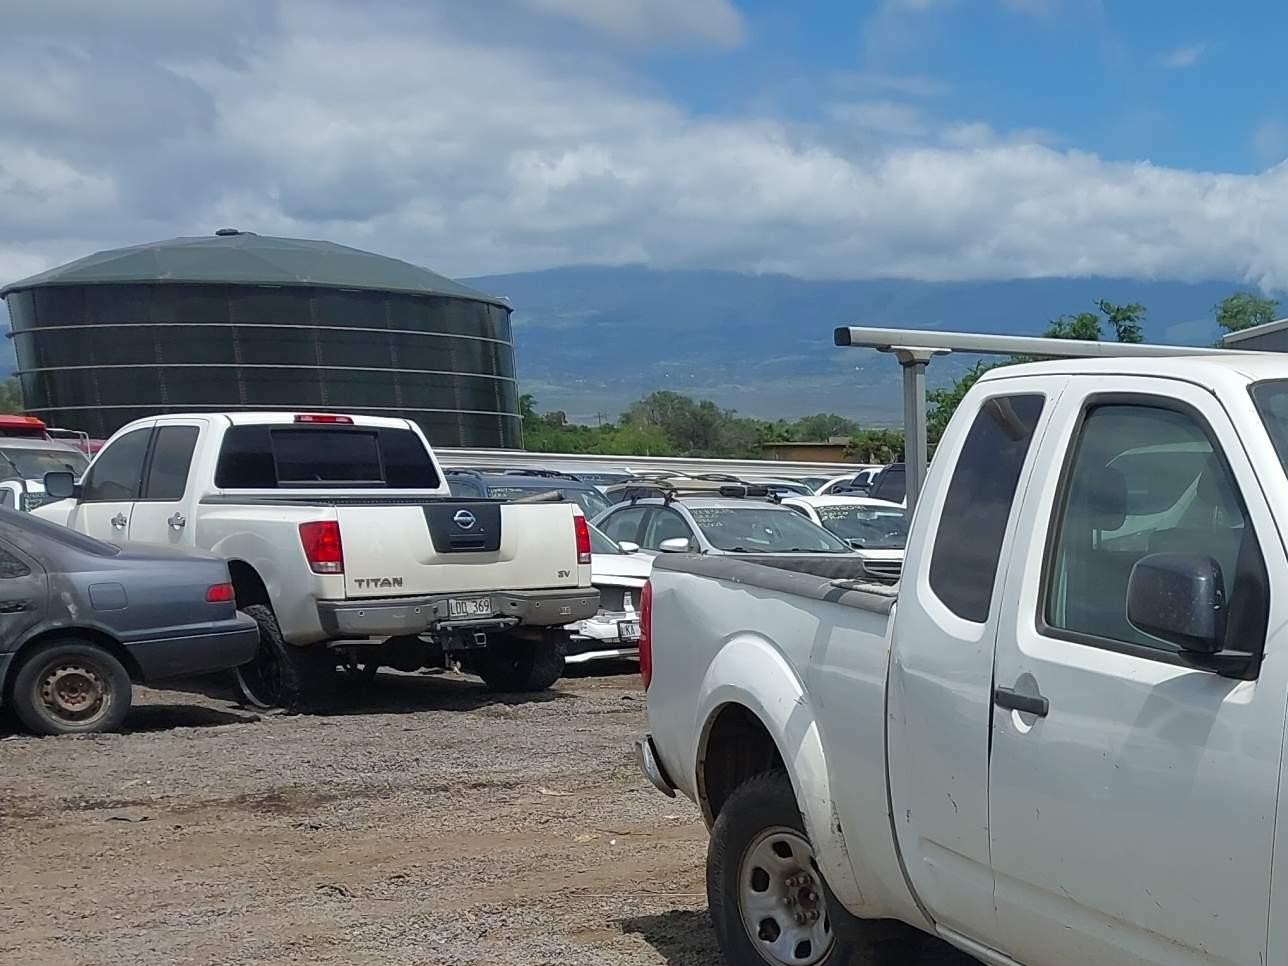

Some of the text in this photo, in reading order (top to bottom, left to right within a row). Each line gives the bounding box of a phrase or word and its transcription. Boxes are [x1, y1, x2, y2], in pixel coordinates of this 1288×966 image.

[557, 570, 571, 579] SV
[353, 576, 403, 589] TITAN
[471, 599, 491, 613] 369
